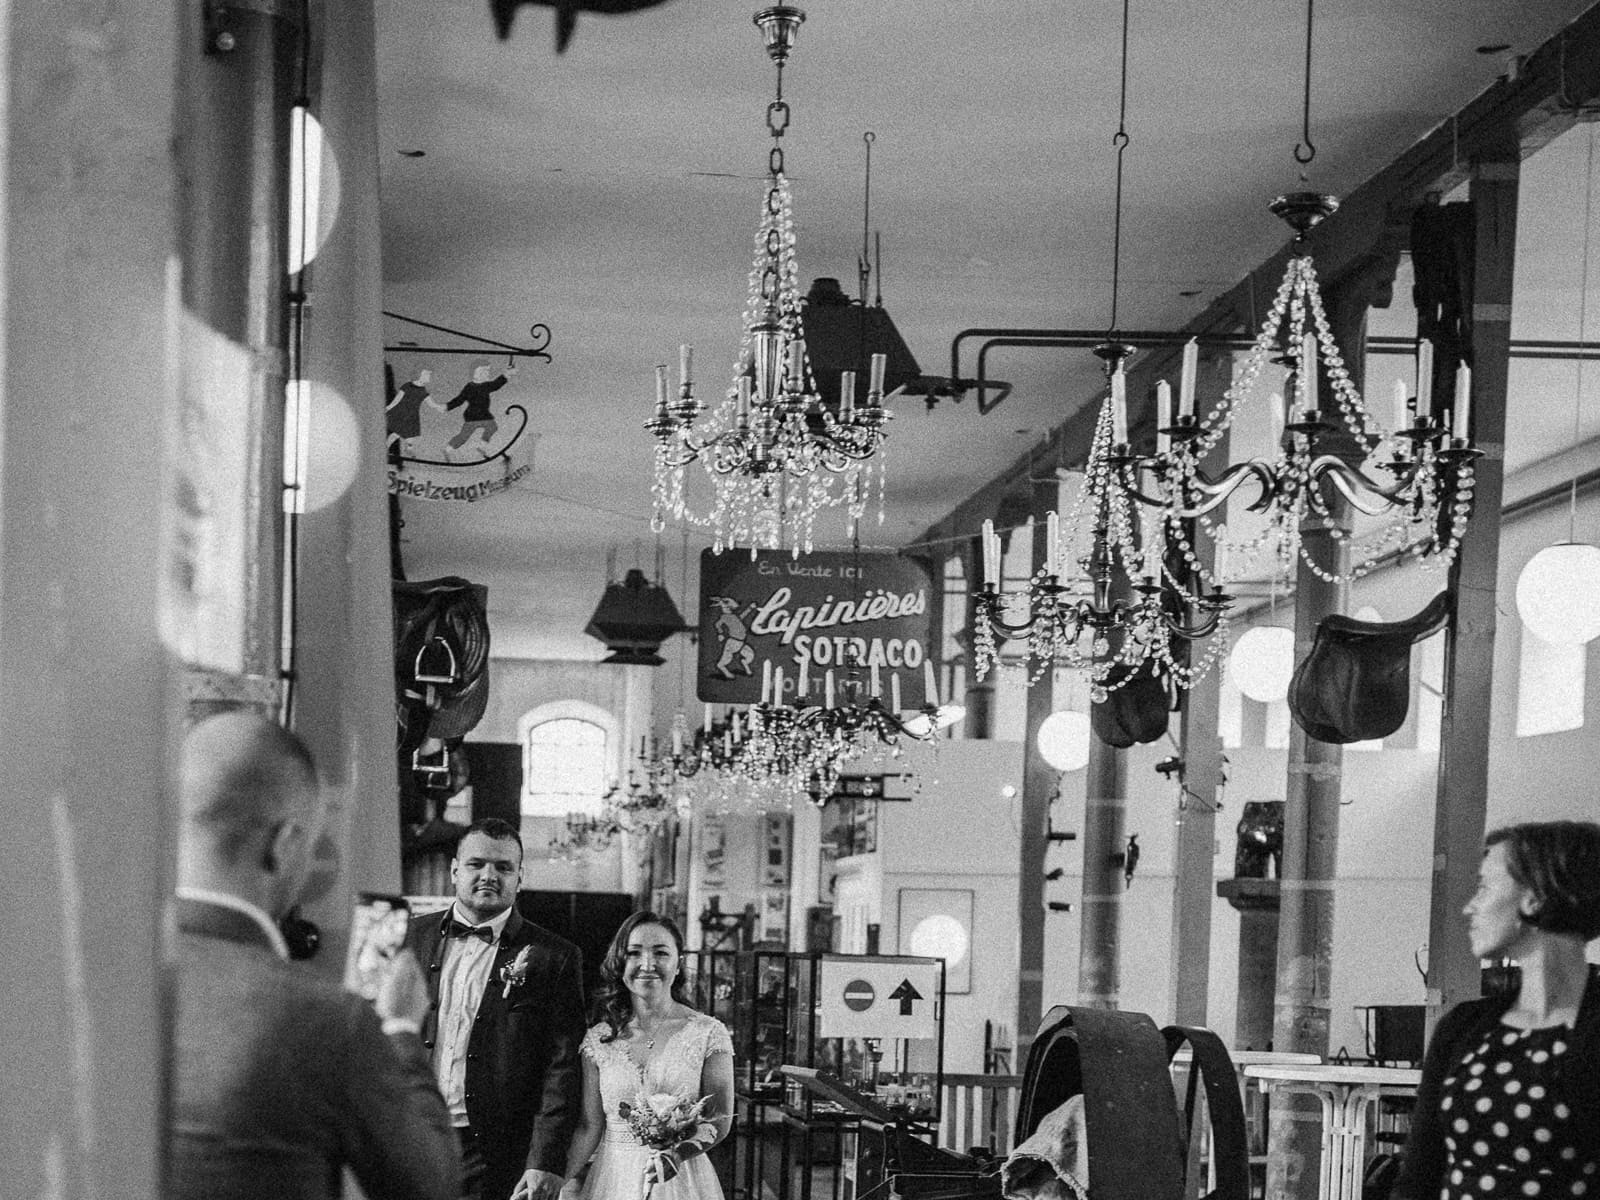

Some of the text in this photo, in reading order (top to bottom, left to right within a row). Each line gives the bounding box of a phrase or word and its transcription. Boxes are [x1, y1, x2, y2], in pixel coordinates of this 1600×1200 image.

[387, 471, 478, 503] Spielzeug
[757, 560, 864, 579] En Vente ICI
[792, 634, 923, 669] SOTRACO
